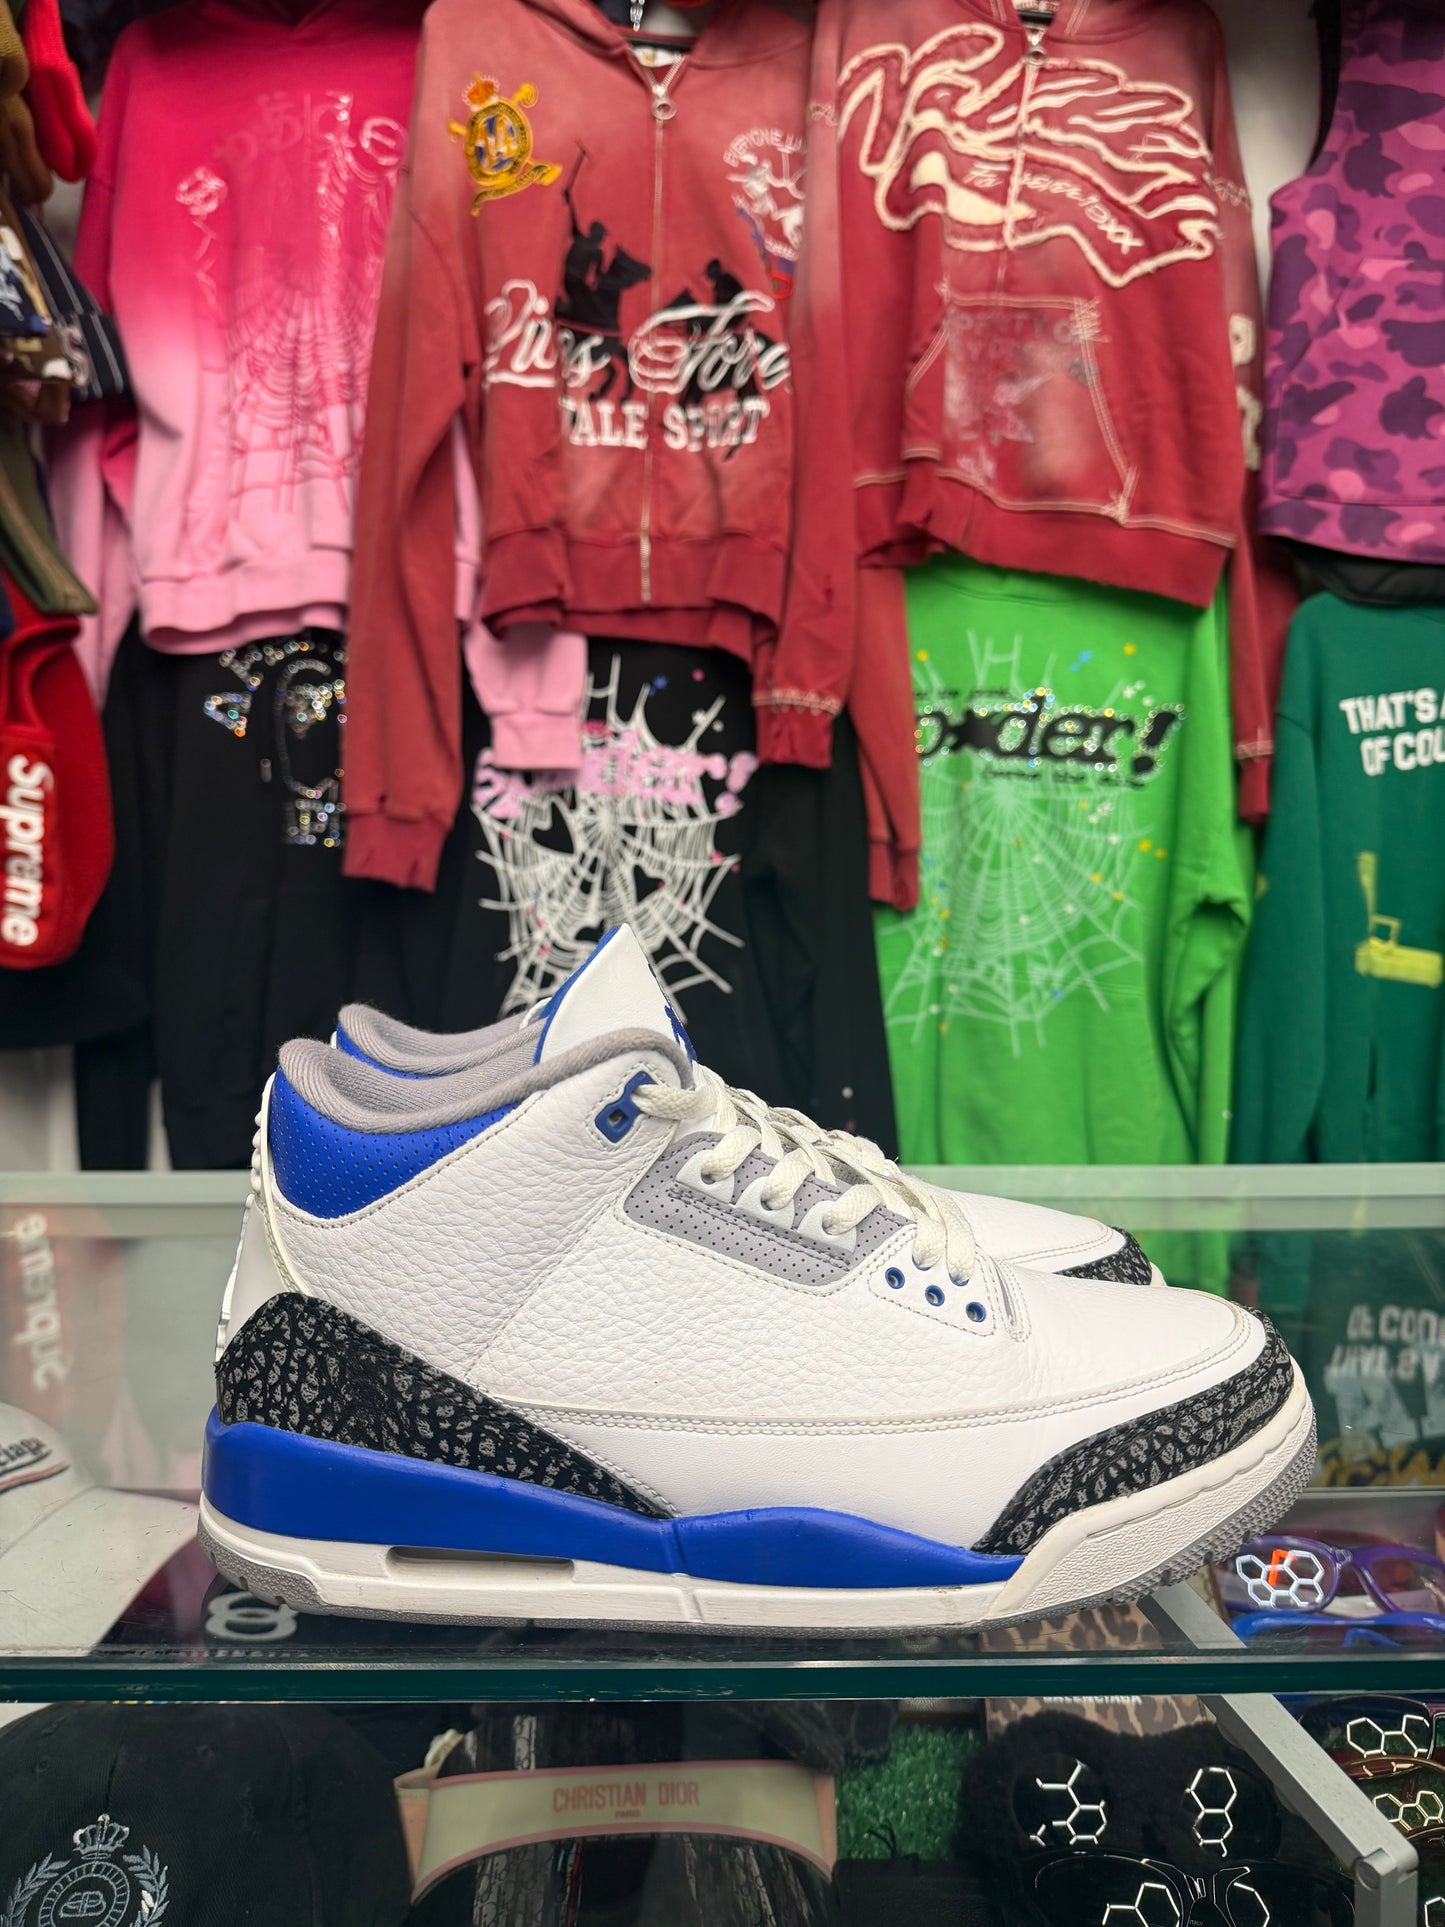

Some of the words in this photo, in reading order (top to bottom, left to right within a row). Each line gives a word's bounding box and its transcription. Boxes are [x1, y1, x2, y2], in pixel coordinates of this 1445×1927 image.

[1338, 687, 1438, 734] THAT'S
[1360, 735, 1391, 777] OF
[0, 753, 54, 947] Supreme
[553, 1782, 647, 1813] CHRISTIAN
[658, 1780, 699, 1806] DIOR
